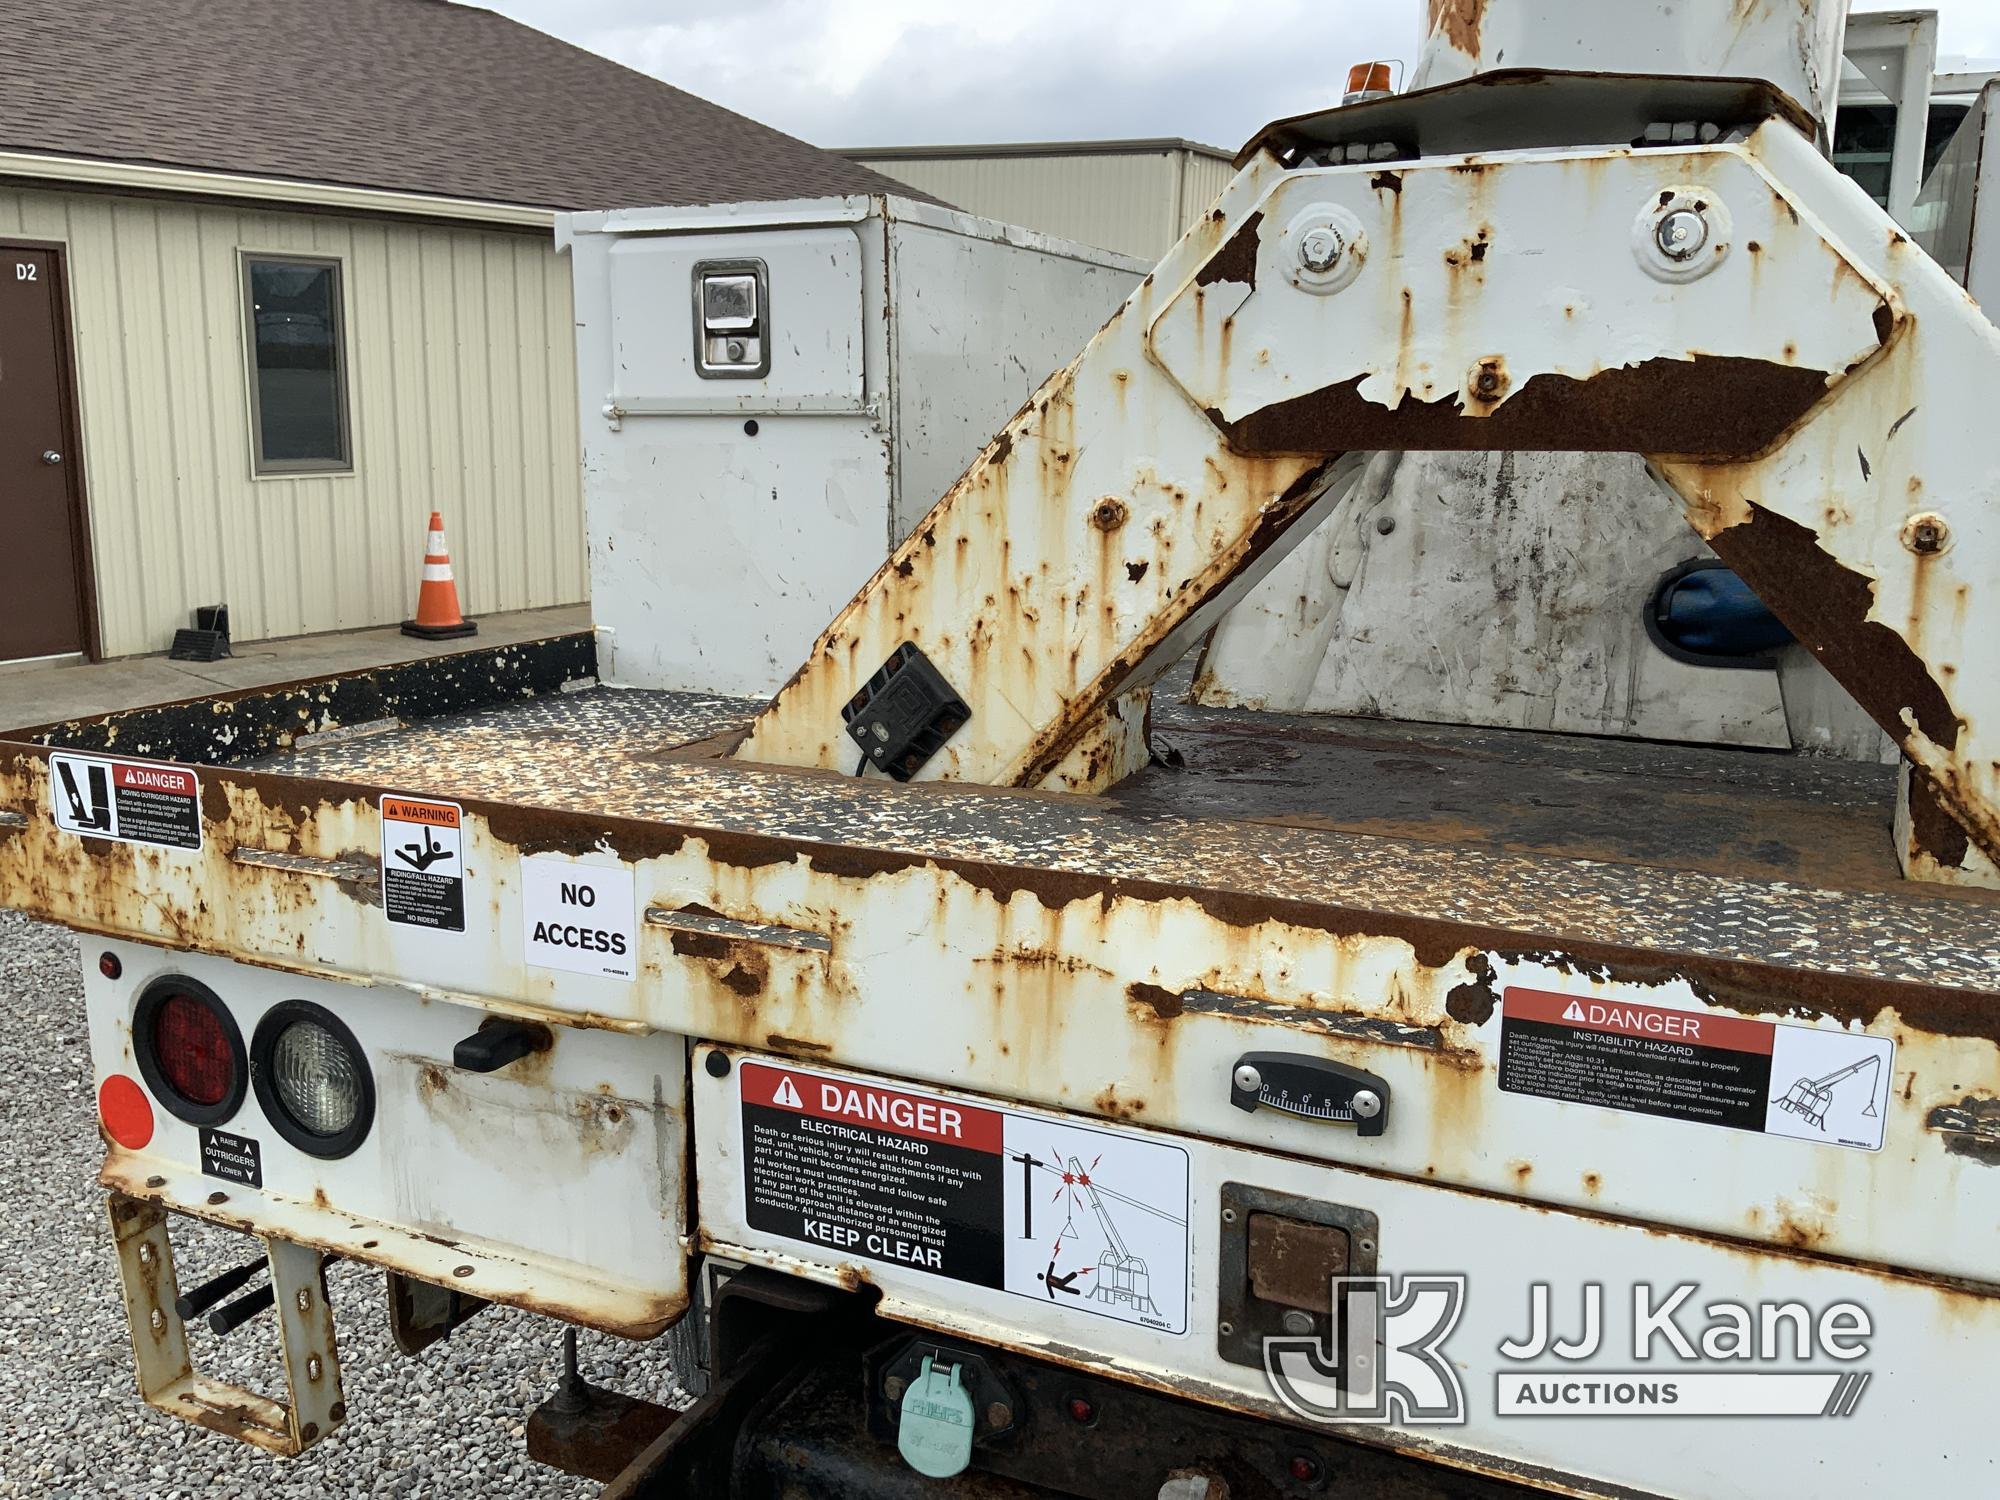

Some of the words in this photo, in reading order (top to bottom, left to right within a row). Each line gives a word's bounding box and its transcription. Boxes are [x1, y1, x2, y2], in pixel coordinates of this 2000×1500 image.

[16, 263, 37, 281] D2
[136, 771, 185, 790] DANGER
[121, 789, 140, 798] MOVING
[141, 792, 170, 802] OUTRIGGER
[170, 795, 191, 805] HAZARD
[401, 805, 455, 823] WARNING
[390, 870, 427, 881] RIDING/FALL
[428, 876, 454, 885] HAZARD
[561, 882, 595, 908] NO
[407, 914, 417, 922] NO
[417, 915, 439, 925] RIDERS
[533, 921, 627, 955] ACCESS
[1589, 1005, 1700, 1038] DANGER
[1509, 1031, 1529, 1040] Death
[1539, 1037, 1564, 1046] serious
[1565, 1041, 1584, 1050] injury
[1598, 1046, 1618, 1054] result
[1619, 1048, 1635, 1057] from
[1636, 1051, 1667, 1062] overload
[1678, 1056, 1700, 1066] failure
[1710, 1062, 1740, 1073] properly
[1513, 1045, 1527, 1053] Unit
[1528, 1048, 1550, 1057] tested
[1563, 1052, 1584, 1062] ANSI
[1585, 1055, 1605, 1065] 10.31
[1520, 1041, 1557, 1051] outriggers.
[1573, 1031, 1641, 1048] INSTABILITY
[1644, 1041, 1693, 1056] HAZARD
[1506, 1071, 1537, 1081] required
[1547, 1077, 1565, 1085] level
[1567, 1080, 1581, 1088] unit
[1507, 1058, 1536, 1069] manual,
[1538, 1062, 1563, 1072] before
[1564, 1066, 1586, 1075] boom
[1596, 1072, 1621, 1081] raised,
[1623, 1077, 1661, 1088] extended,
[1674, 1084, 1702, 1094] rotated
[1513, 1051, 1541, 1063] Properly
[1543, 1057, 1554, 1065] set
[1555, 1059, 1590, 1070] outriggers
[1609, 1066, 1623, 1075] firm
[1624, 1070, 1652, 1080] surface,
[1665, 1075, 1701, 1087] described
[1711, 1082, 1723, 1090] the
[1724, 1085, 1756, 1095] operator
[1527, 1067, 1546, 1076] slope
[1547, 1071, 1577, 1080] indicator
[1605, 1080, 1625, 1089] setup
[1626, 1082, 1633, 1090] to
[1635, 1084, 1654, 1093] show
[1655, 1086, 1661, 1094] if
[1662, 1089, 1697, 1099] additional
[1699, 1094, 1735, 1105] measures
[1737, 1100, 1749, 1108] are
[1281, 1090, 1288, 1098] 5
[1324, 1098, 1331, 1107] 5
[1510, 1083, 1521, 1091] Do
[1535, 1088, 1560, 1097] exceed
[1561, 1092, 1579, 1100] rated
[1581, 1095, 1610, 1106] capacity
[821, 1084, 961, 1138] DANGER
[220, 1136, 238, 1147] RAISE
[754, 1124, 778, 1137] Death
[792, 1134, 824, 1147] serious
[826, 1140, 852, 1155] injury
[854, 1147, 869, 1157] will
[872, 1151, 898, 1163] result
[901, 1156, 921, 1168] from
[924, 1163, 959, 1177] contact
[961, 1170, 981, 1181] with
[800, 1119, 874, 1144] ELECTRICAL
[877, 1135, 928, 1155] HAZARD
[205, 1146, 255, 1168] OUTRIGGERS
[220, 1165, 242, 1177] LOWER
[754, 1134, 775, 1147] load,
[777, 1141, 796, 1152] unit,
[798, 1145, 831, 1160] vehicle,
[834, 1153, 843, 1161] or
[846, 1156, 877, 1169] vehicle
[879, 1163, 935, 1182] attachments
[938, 1174, 944, 1184] if
[947, 1178, 963, 1189] any
[754, 1146, 771, 1156] part
[774, 1149, 782, 1158] of
[785, 1151, 798, 1161] the
[801, 1156, 817, 1166] unit
[820, 1158, 859, 1175] becomes
[861, 1169, 907, 1186] energized.
[753, 1156, 764, 1166] All
[767, 1160, 800, 1174] workers
[803, 1168, 824, 1179] must
[826, 1174, 876, 1191] understand
[878, 1185, 895, 1195] and
[898, 1188, 925, 1202] follow
[928, 1196, 947, 1207] safe
[753, 1166, 792, 1182] electrical
[794, 1176, 815, 1187] work
[818, 1181, 860, 1197] practices.
[754, 1175, 760, 1184] If
[762, 1178, 777, 1189] any
[779, 1182, 796, 1193] part
[799, 1186, 807, 1195] of
[810, 1188, 823, 1199] the
[826, 1193, 843, 1203] unit
[845, 1196, 853, 1206] is
[856, 1199, 892, 1215] elevated
[895, 1209, 922, 1222] within
[925, 1215, 940, 1226] the
[754, 1186, 792, 1201] minimum
[795, 1195, 834, 1211] approach
[837, 1205, 874, 1220] distance
[876, 1215, 885, 1223] of
[888, 1218, 899, 1227] an
[901, 1221, 946, 1237] energized
[754, 1196, 799, 1213] conductor.
[802, 1206, 813, 1216] All
[816, 1210, 872, 1230] unauthorized
[875, 1225, 919, 1241] personnel
[922, 1236, 944, 1247] must
[804, 1218, 860, 1246] KEEP
[866, 1234, 941, 1268] CLEAR
